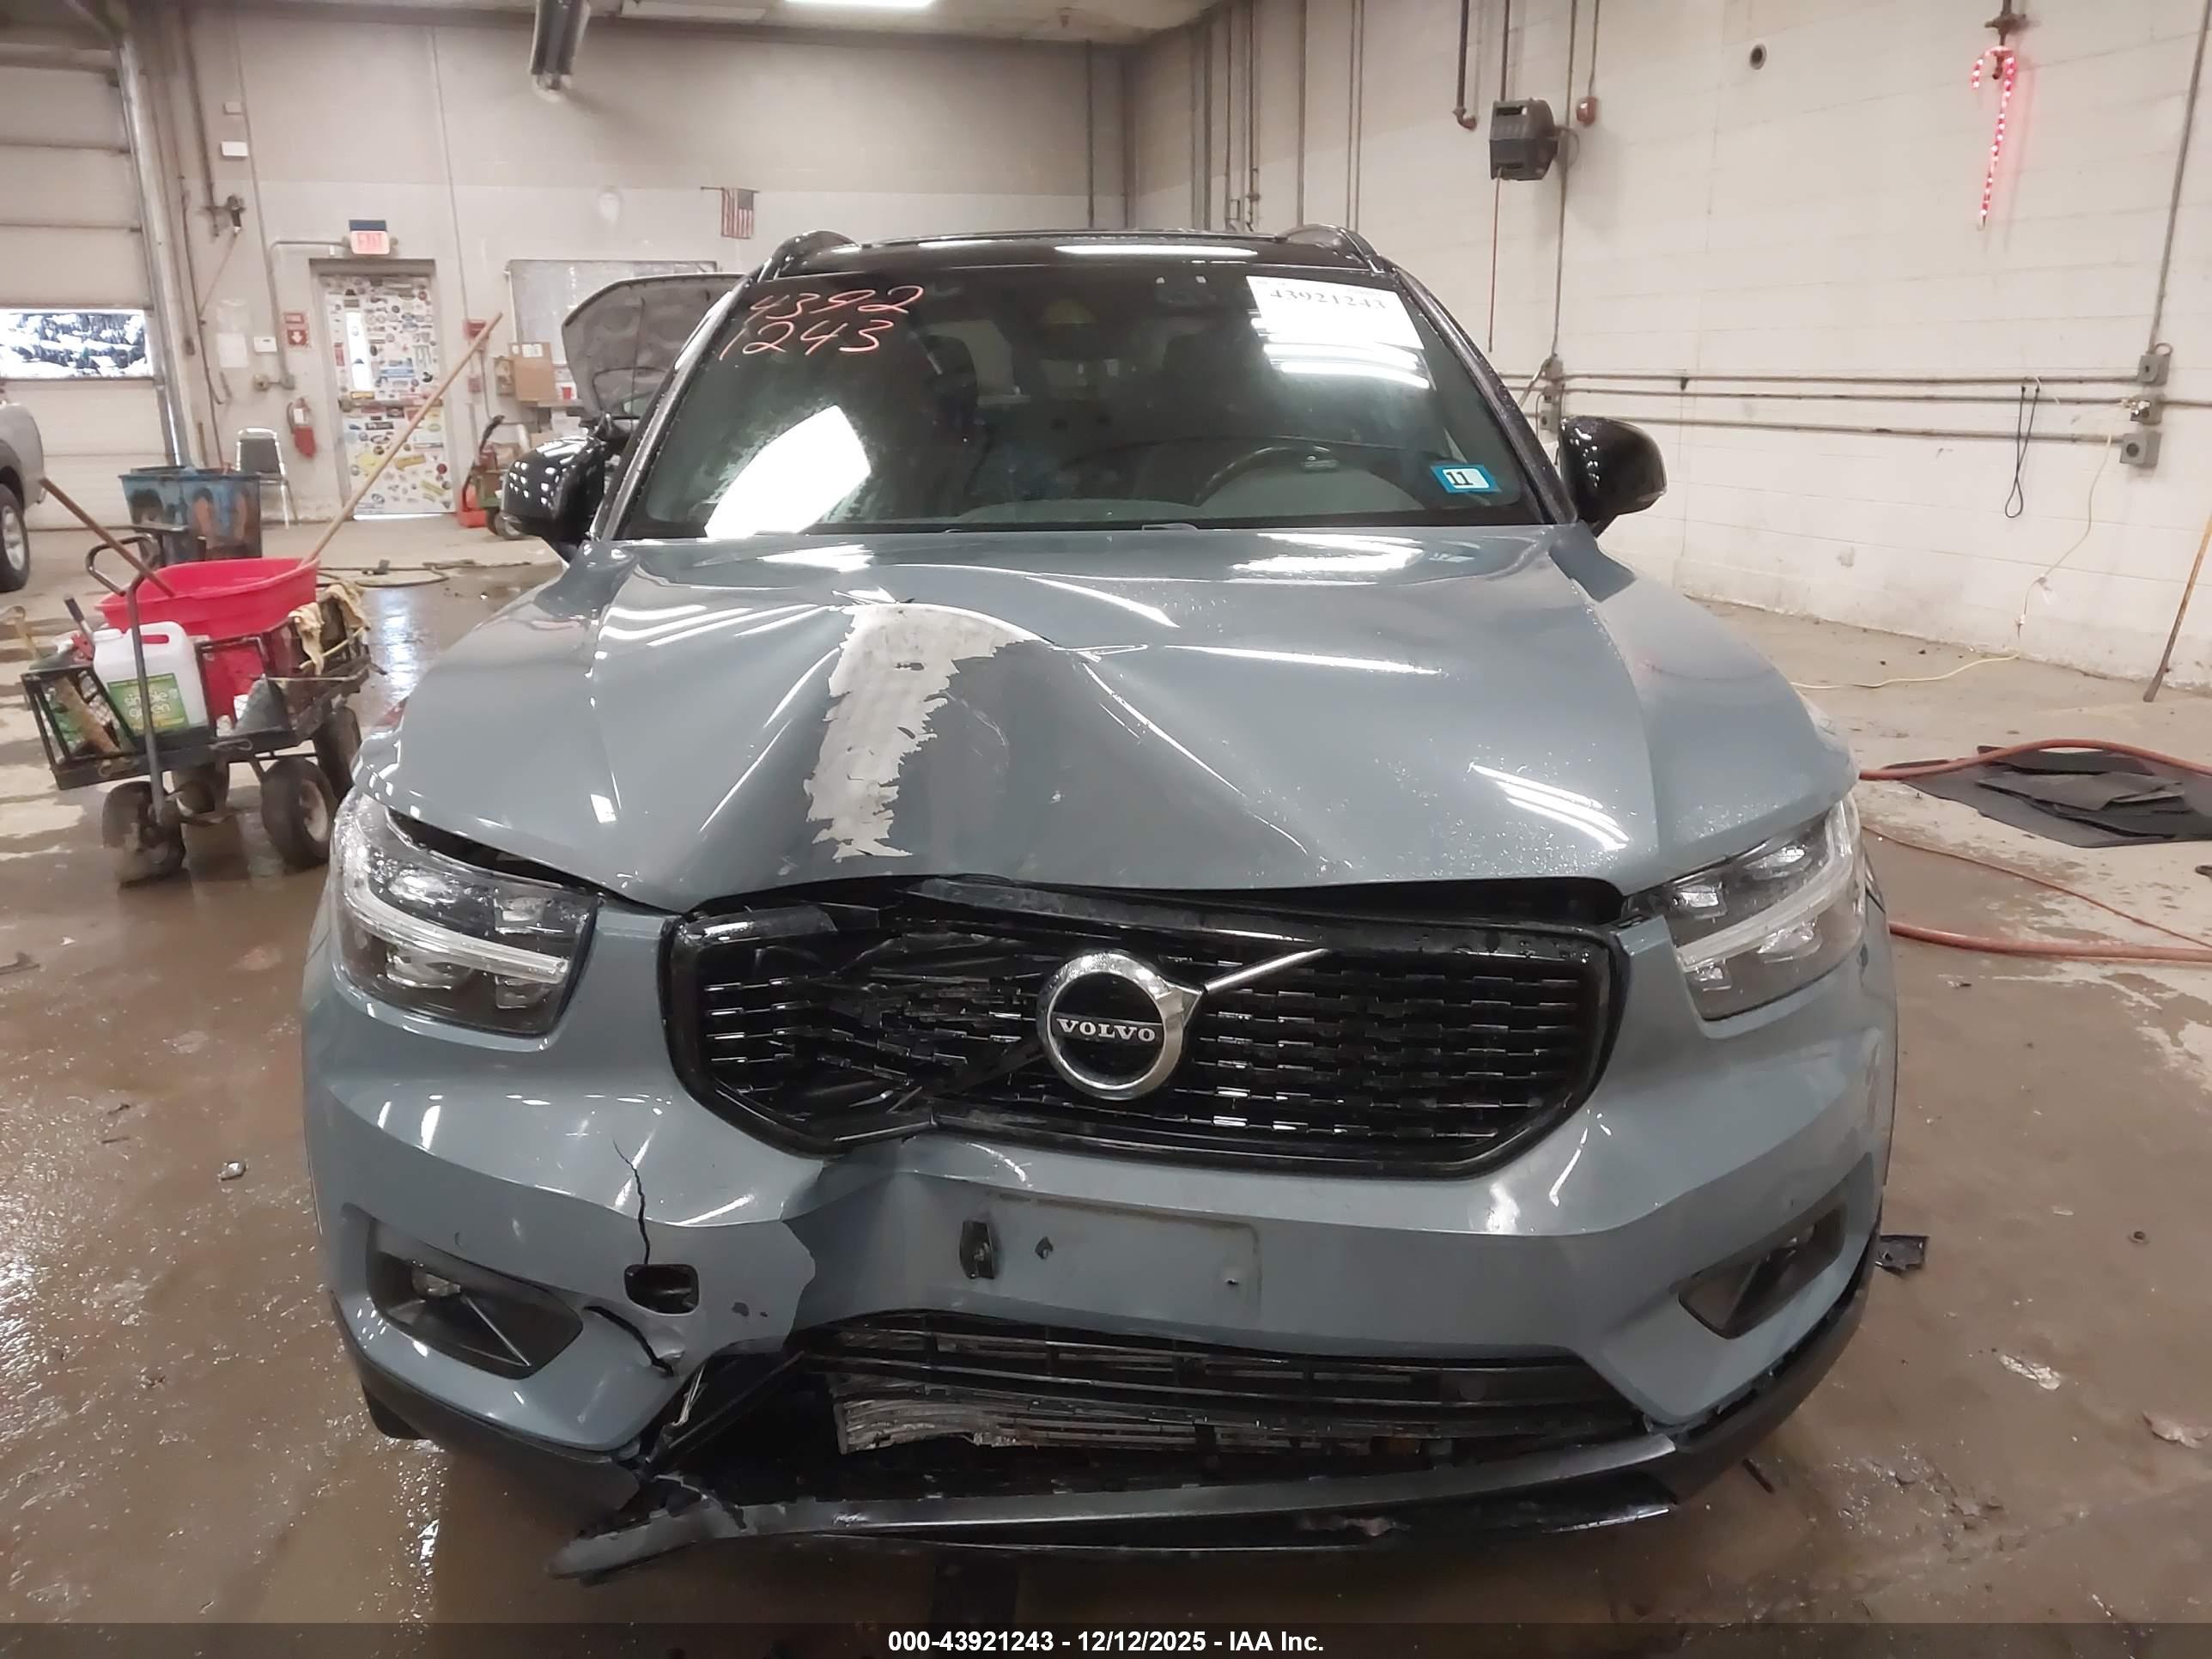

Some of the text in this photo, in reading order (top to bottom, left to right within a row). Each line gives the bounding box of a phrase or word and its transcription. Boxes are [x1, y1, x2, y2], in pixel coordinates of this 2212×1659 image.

[744, 285, 924, 325] 4392
[1270, 287, 1387, 310] 43921243
[719, 320, 894, 361] 1243
[1445, 471, 1474, 486] 11
[124, 689, 169, 708] simle
[129, 702, 172, 720] gen
[1055, 1018, 1157, 1042] VOLVO
